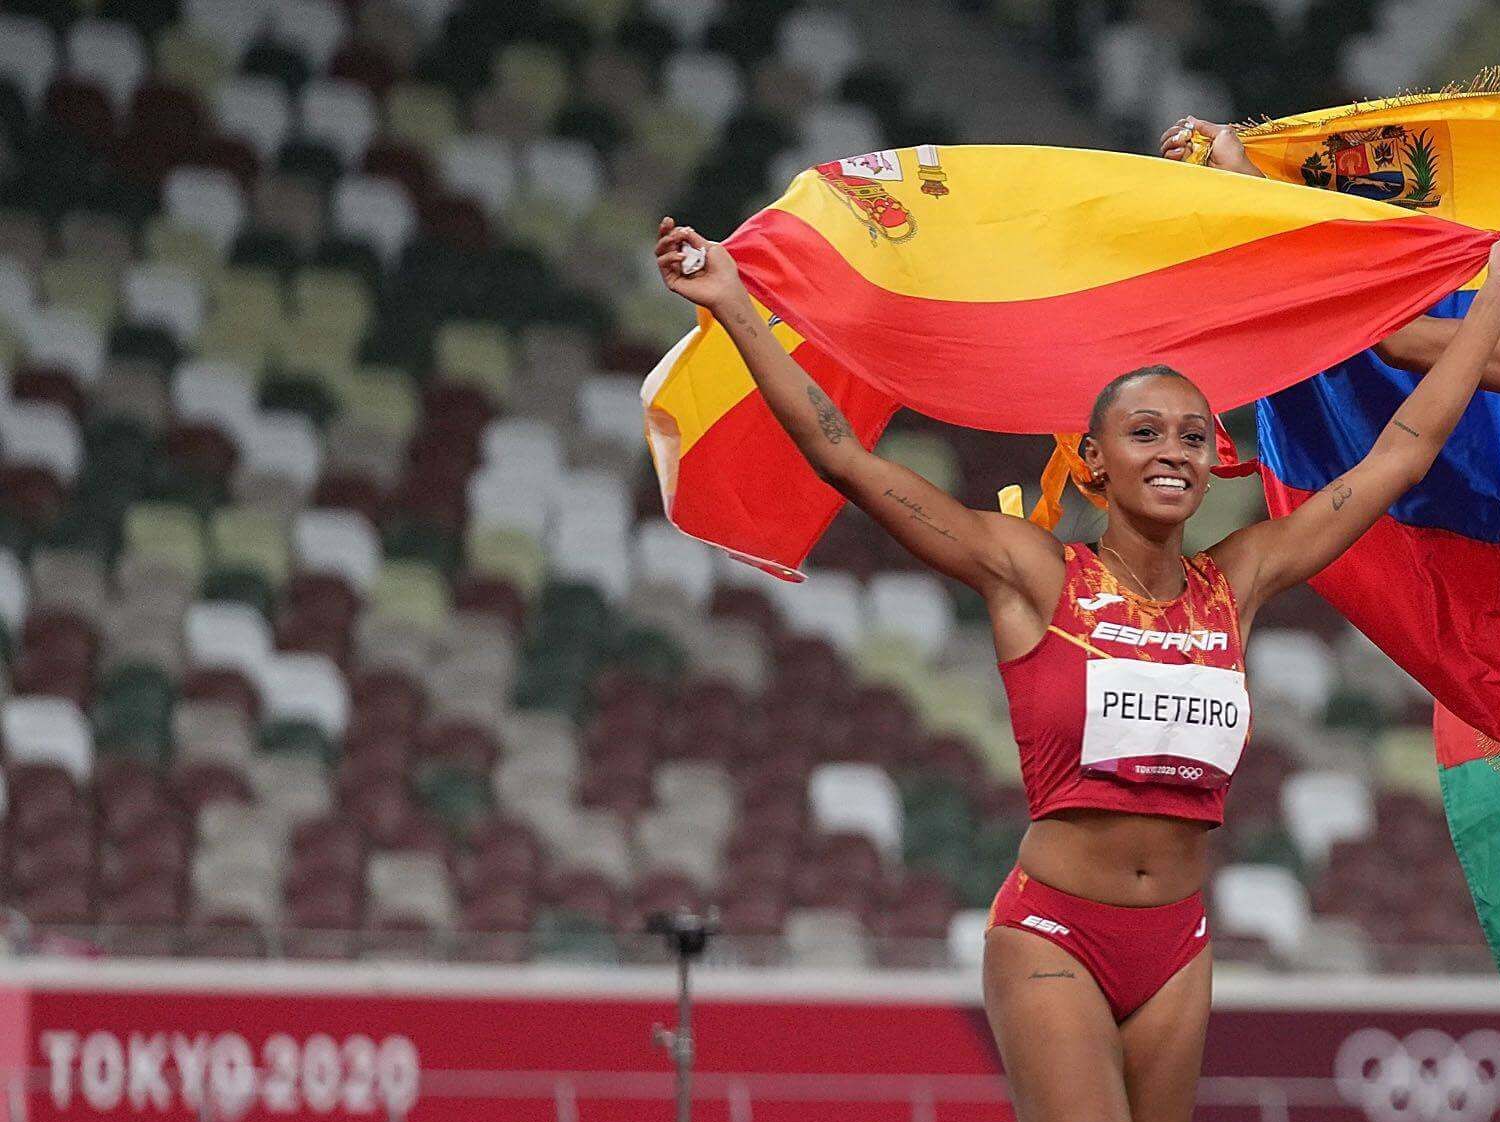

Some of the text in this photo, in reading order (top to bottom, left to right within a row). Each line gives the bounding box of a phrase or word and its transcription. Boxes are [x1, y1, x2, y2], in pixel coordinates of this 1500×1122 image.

[1091, 621, 1228, 652] ESPAÑA
[1102, 691, 1238, 729] PELETEIRO
[1020, 913, 1071, 936] ESP
[41, 1030, 420, 1115] TOKYO 2020
